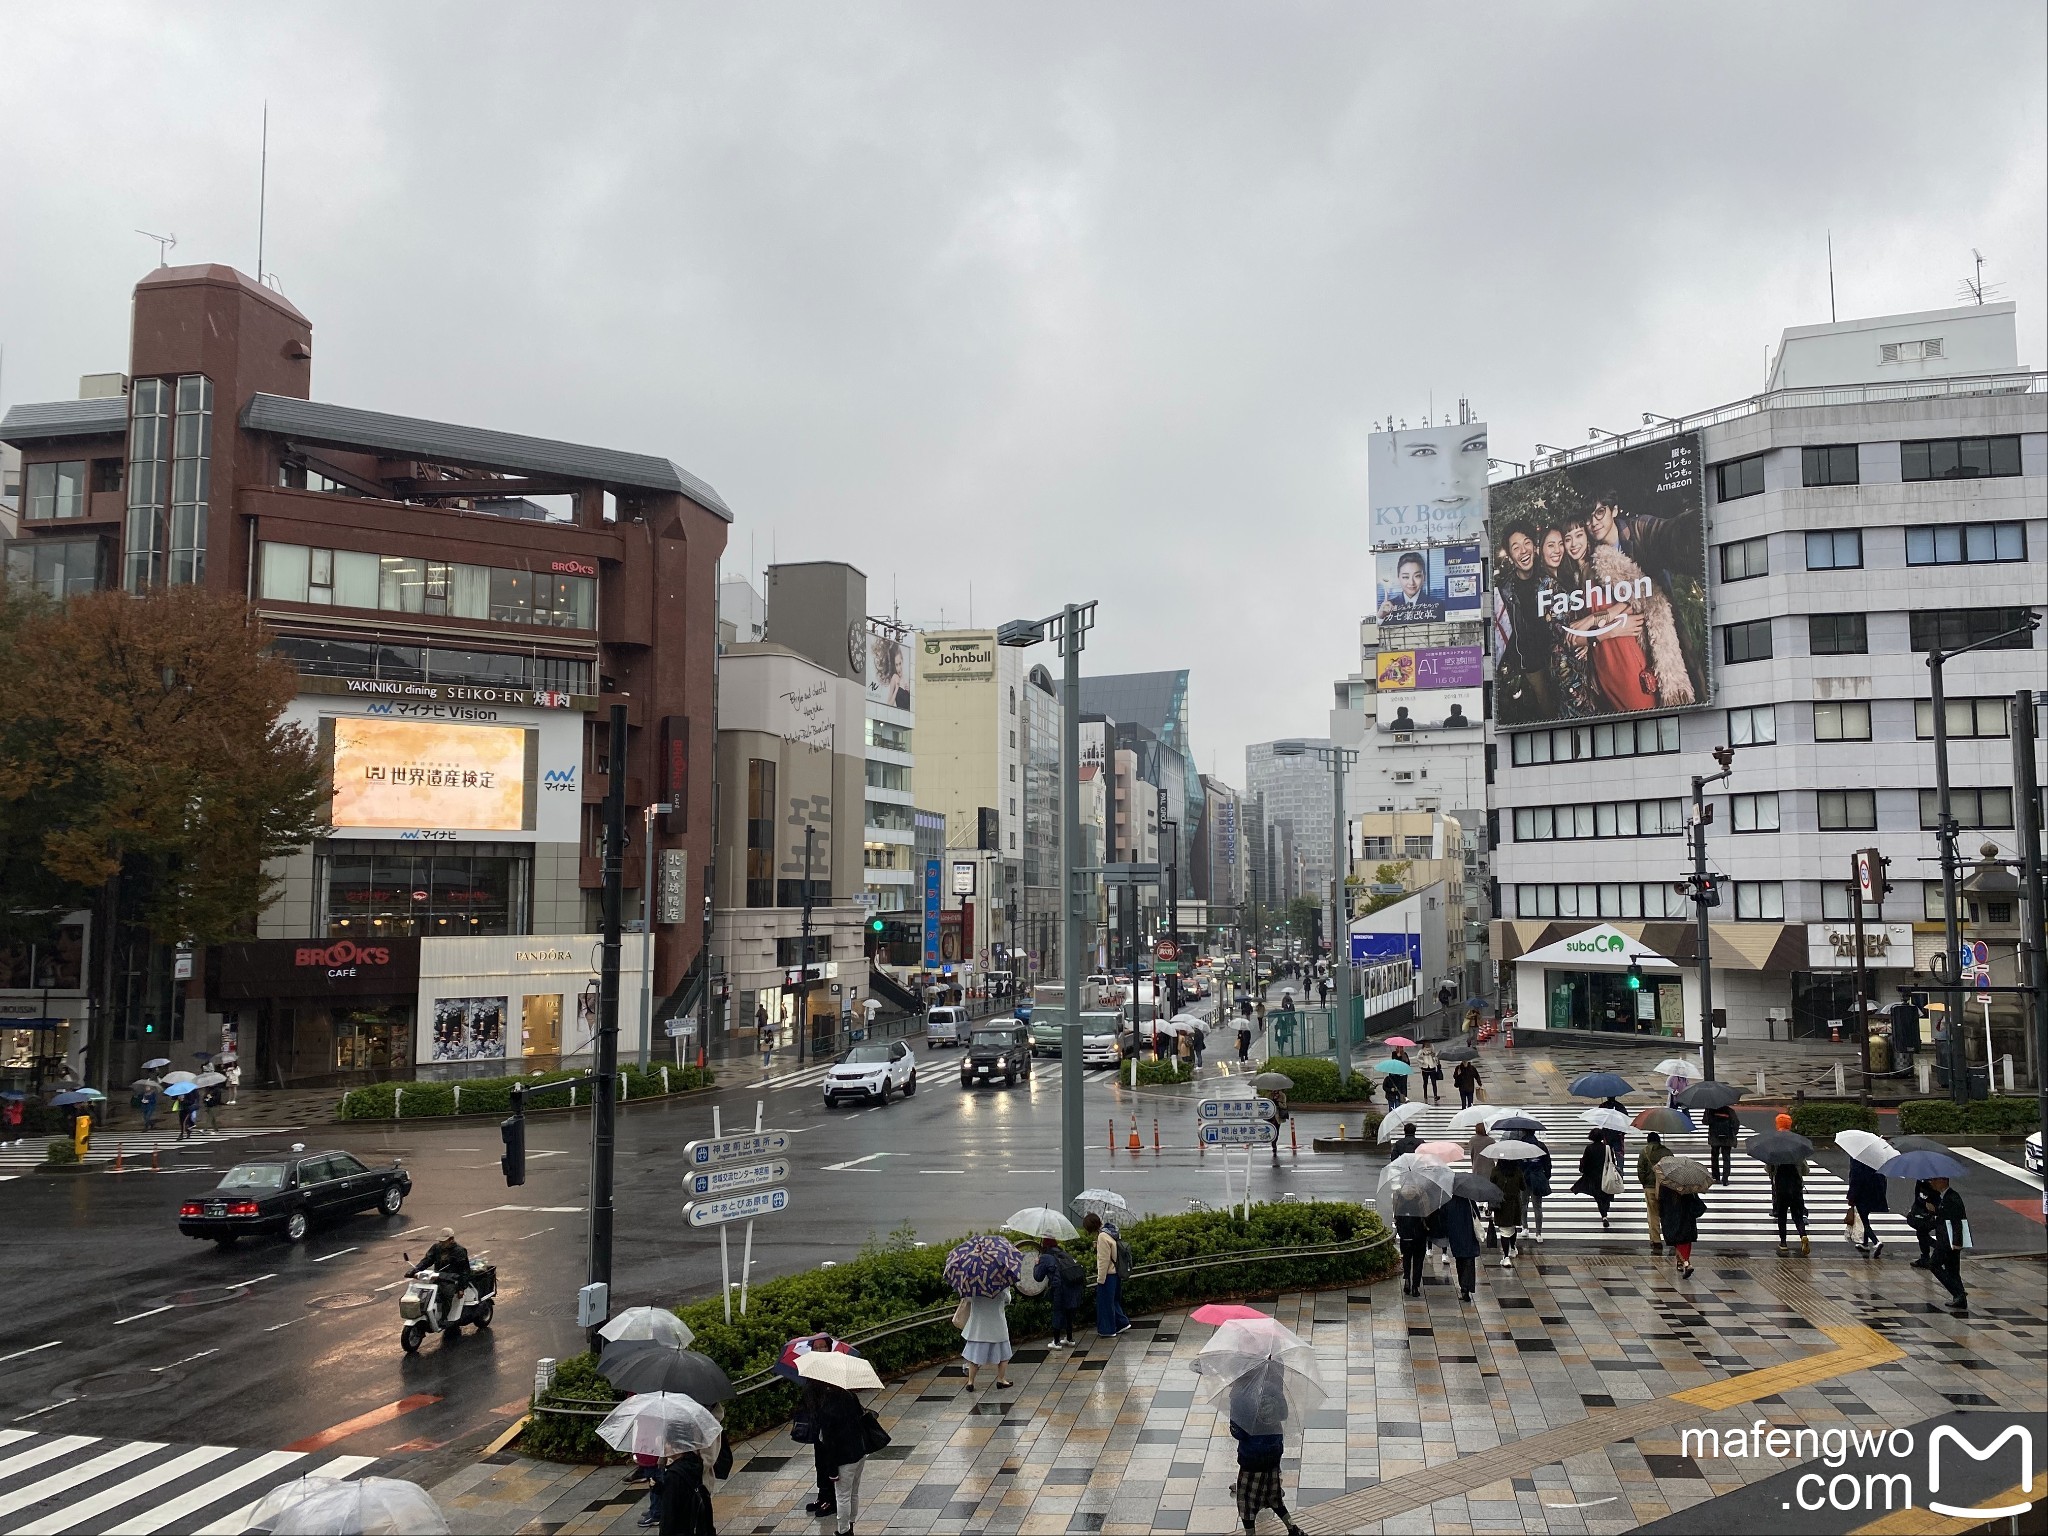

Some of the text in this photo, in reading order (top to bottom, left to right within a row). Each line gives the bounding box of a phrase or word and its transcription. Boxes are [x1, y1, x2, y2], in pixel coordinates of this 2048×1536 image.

[1671, 447, 1692, 458] 服も。
[1664, 458, 1692, 470] コレも。
[1664, 469, 1692, 481] いつも。
[1656, 477, 1692, 493] Amazon
[1375, 505, 1409, 526] KY
[551, 560, 594, 575] BROOK'S
[1537, 576, 1653, 617] Fashion
[939, 651, 991, 666] Johnbull
[1417, 658, 1438, 675] AI
[1448, 676, 1463, 684] OUT
[346, 679, 524, 702] YAKINIKU dining SEIKO-EN
[533, 691, 570, 708] 焼肉
[397, 702, 497, 721] マイナビ Vision
[391, 767, 496, 789] 世界遺産検定
[544, 783, 576, 792] マイナビ
[422, 830, 457, 840] マイナビ
[294, 940, 389, 967] BROOK'S
[328, 968, 356, 978] CAFÉ
[713, 1137, 770, 1154] 神宮前出張所
[733, 1178, 755, 1187] Community
[712, 1195, 769, 1213] はあとぴあ原宿
